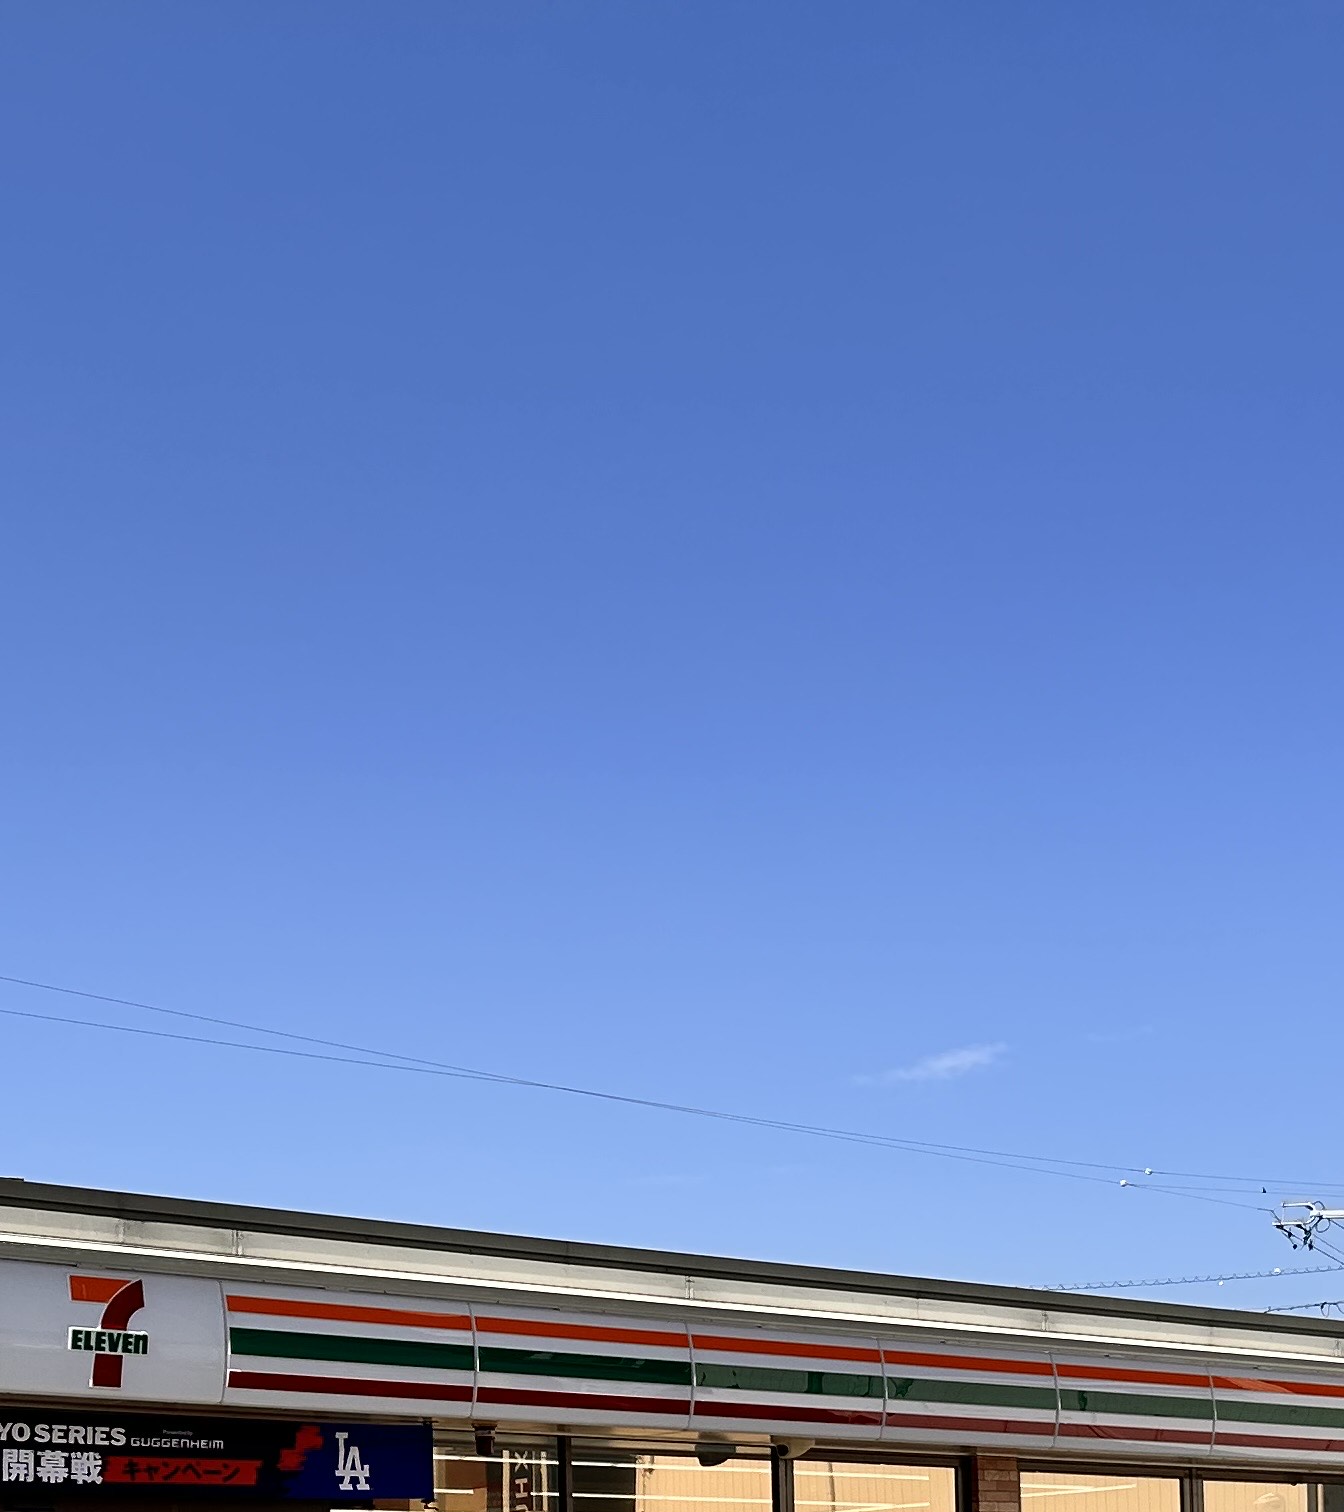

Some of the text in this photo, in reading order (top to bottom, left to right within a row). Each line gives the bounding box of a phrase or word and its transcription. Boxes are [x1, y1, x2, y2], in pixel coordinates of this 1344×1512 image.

[34, 1423, 126, 1447] SERIES
[122, 1458, 241, 1482] キャンペーン
